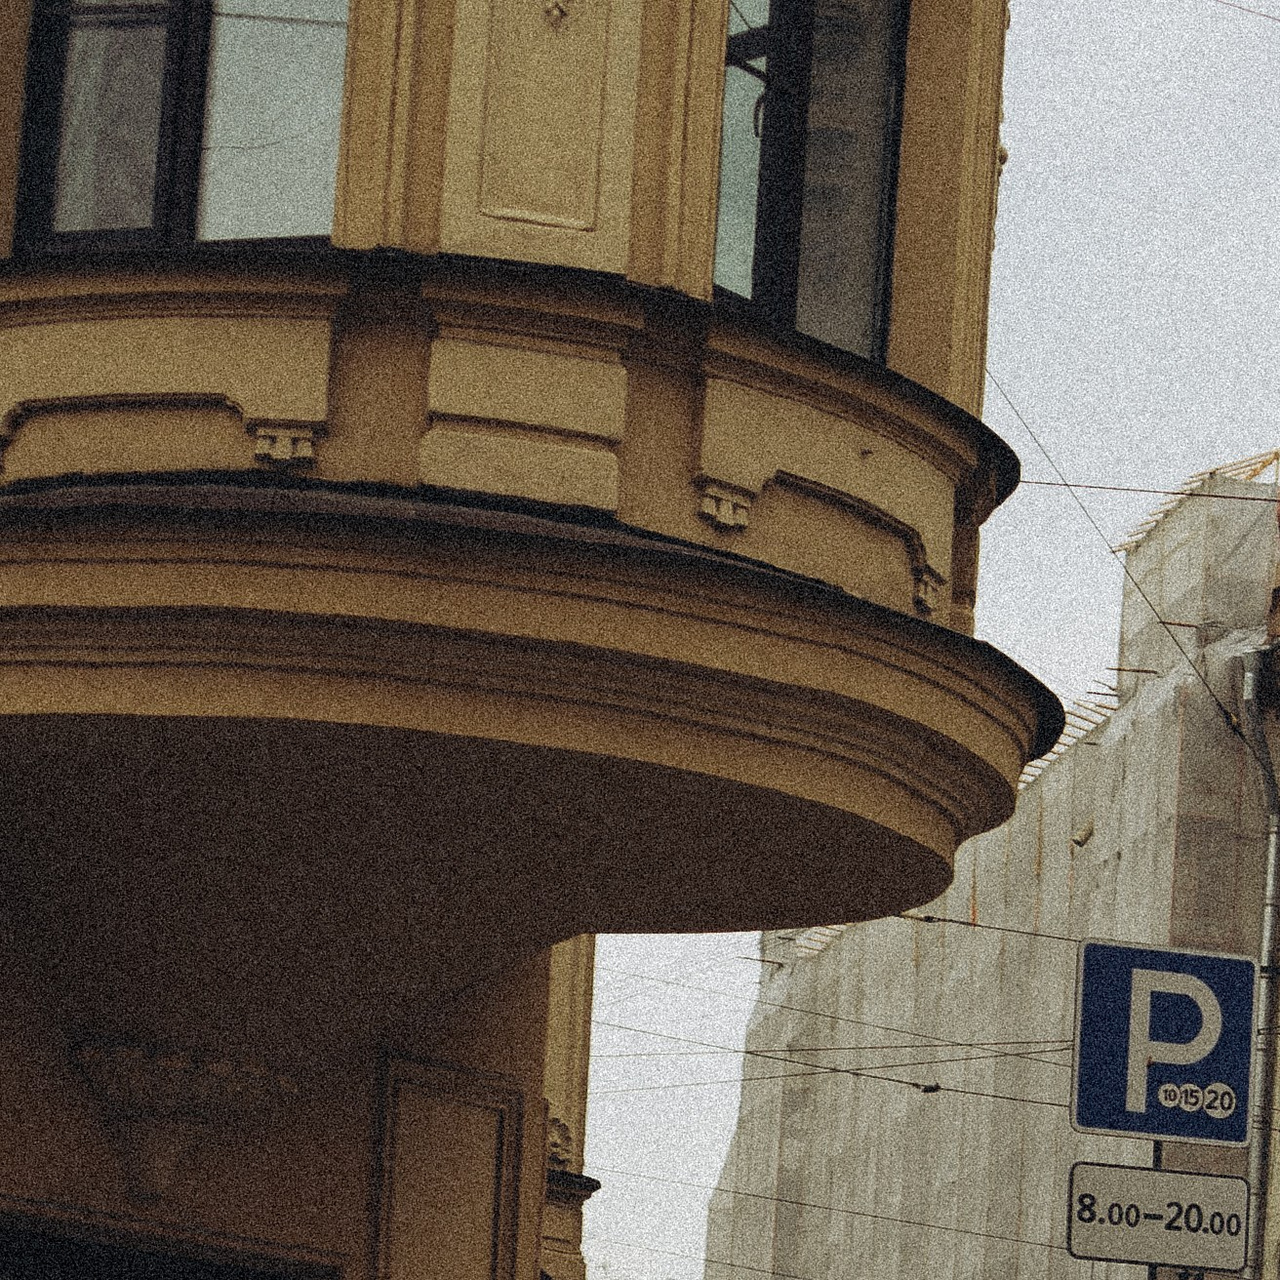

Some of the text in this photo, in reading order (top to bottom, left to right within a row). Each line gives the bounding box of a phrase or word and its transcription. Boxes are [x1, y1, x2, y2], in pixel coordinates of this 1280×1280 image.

[1124, 967, 1223, 1115] P
[1162, 1088, 1234, 1112] 10 15 20
